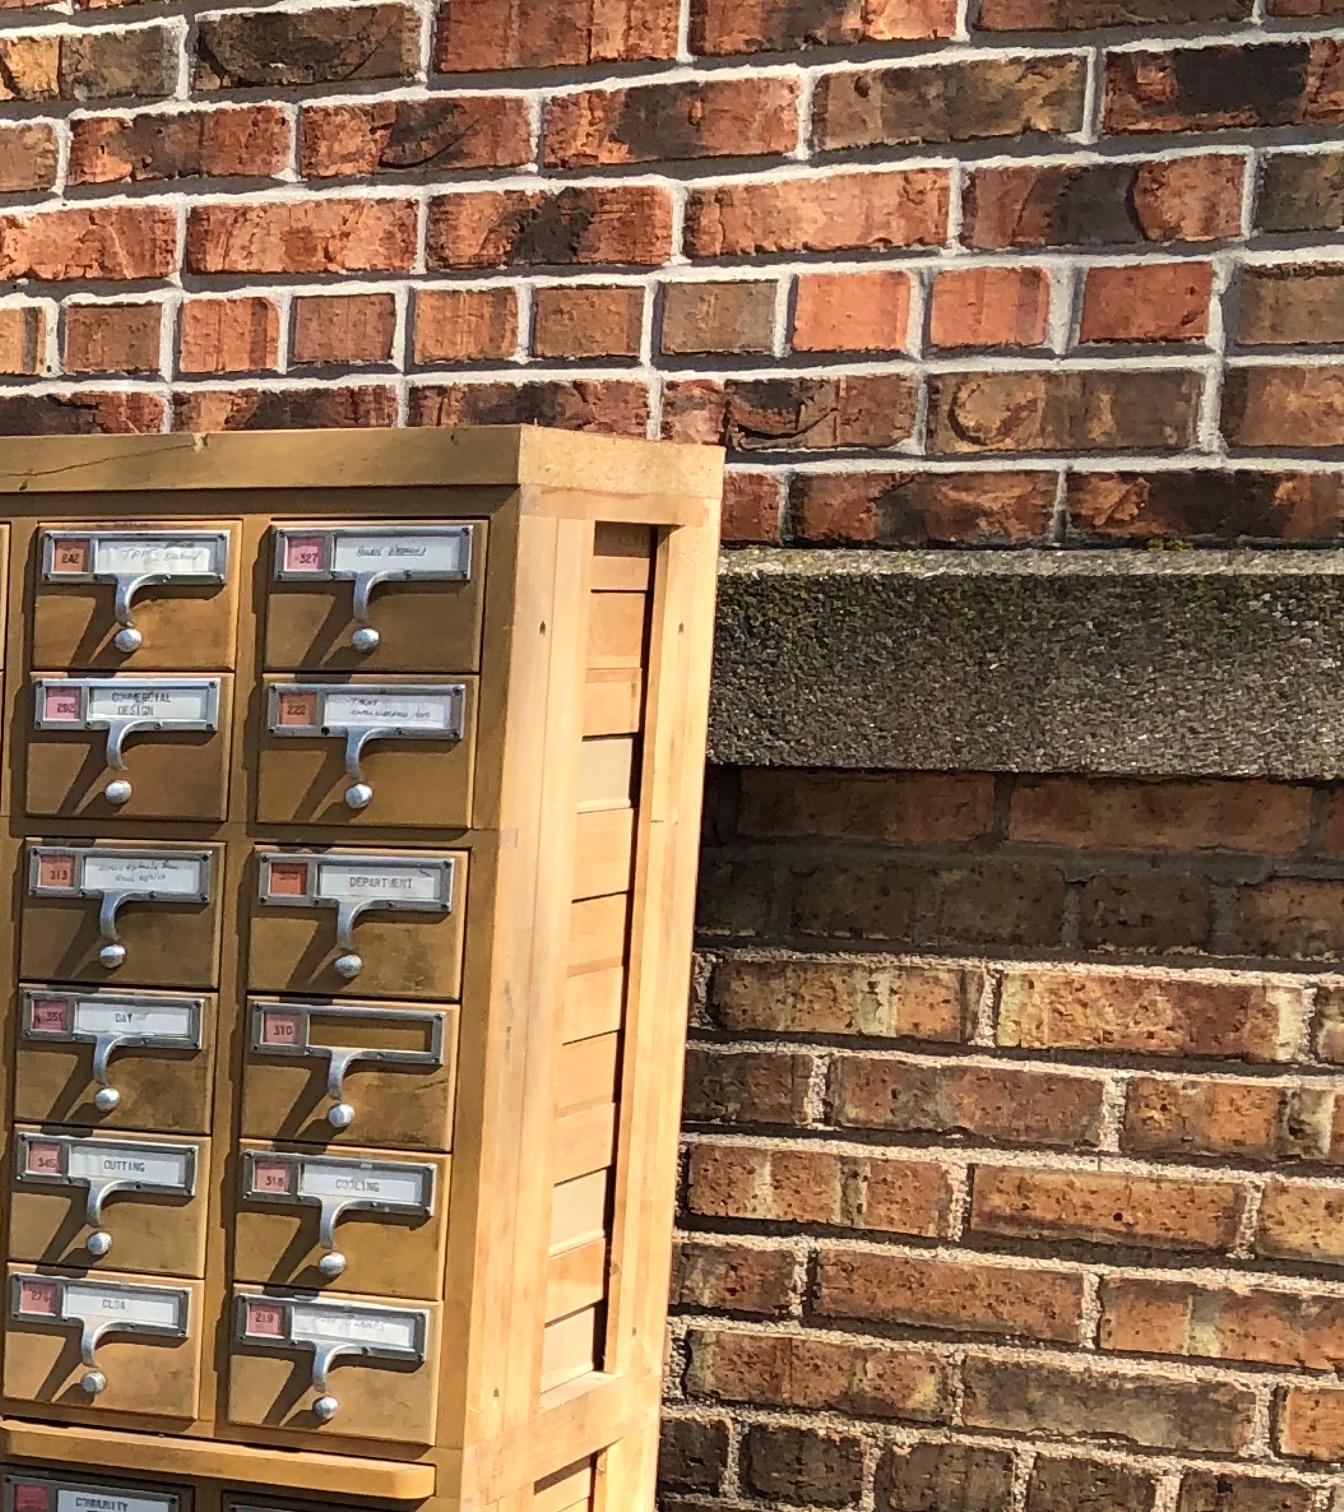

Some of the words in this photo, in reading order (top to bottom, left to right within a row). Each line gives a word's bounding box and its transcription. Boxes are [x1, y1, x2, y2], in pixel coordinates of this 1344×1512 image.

[299, 553, 318, 563] 327
[112, 692, 170, 703] COMMERCIAL
[118, 705, 154, 715] DESIGN
[287, 705, 306, 715] 222
[50, 870, 68, 880] 313
[349, 877, 413, 889] DEPARTMENT
[115, 1013, 132, 1023] DAY
[104, 1160, 145, 1172] CUTTING
[76, 1497, 128, 1511] COMMUNITY
